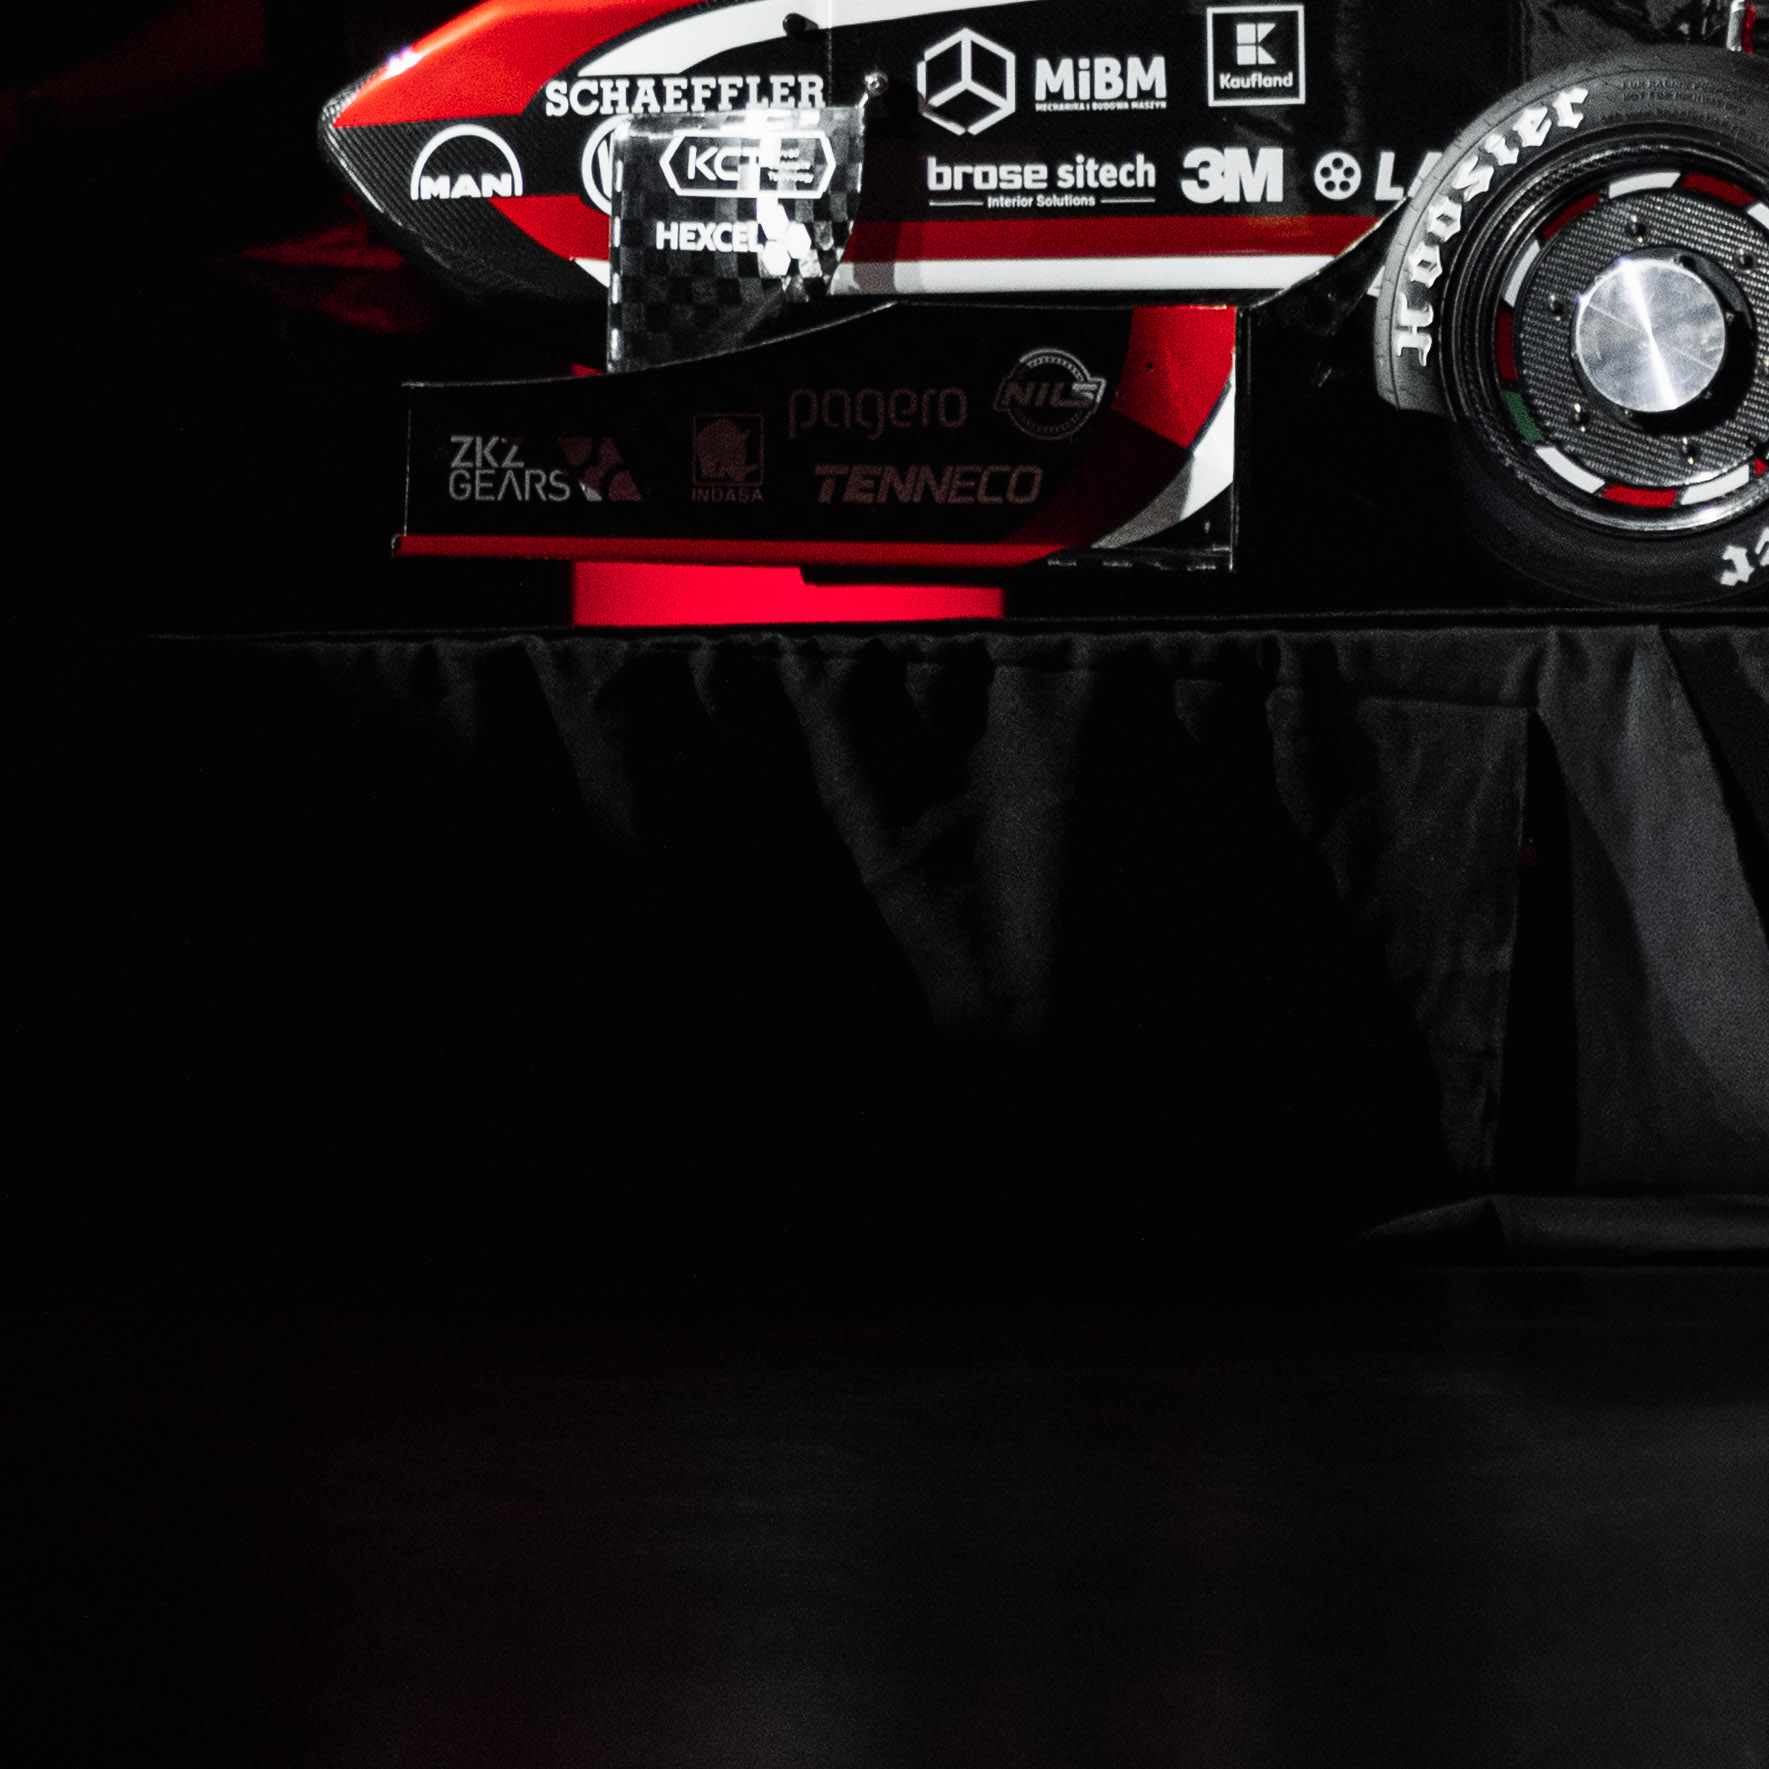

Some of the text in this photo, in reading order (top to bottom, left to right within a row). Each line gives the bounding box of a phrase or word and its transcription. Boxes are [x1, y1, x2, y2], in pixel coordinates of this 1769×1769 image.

[545, 73, 827, 118] SCHAEFFLER
[1034, 54, 1168, 102] MiBM
[1218, 70, 1294, 92] Kaufland
[418, 171, 516, 200] MAN
[926, 152, 1156, 191] brose sitech
[1180, 146, 1284, 203] 3M
[986, 193, 1096, 209] Interior Solutions
[655, 220, 764, 253] HEXCEL
[788, 387, 968, 440] pagero
[448, 467, 572, 504] GEARS
[813, 464, 1043, 504] TENNECO
